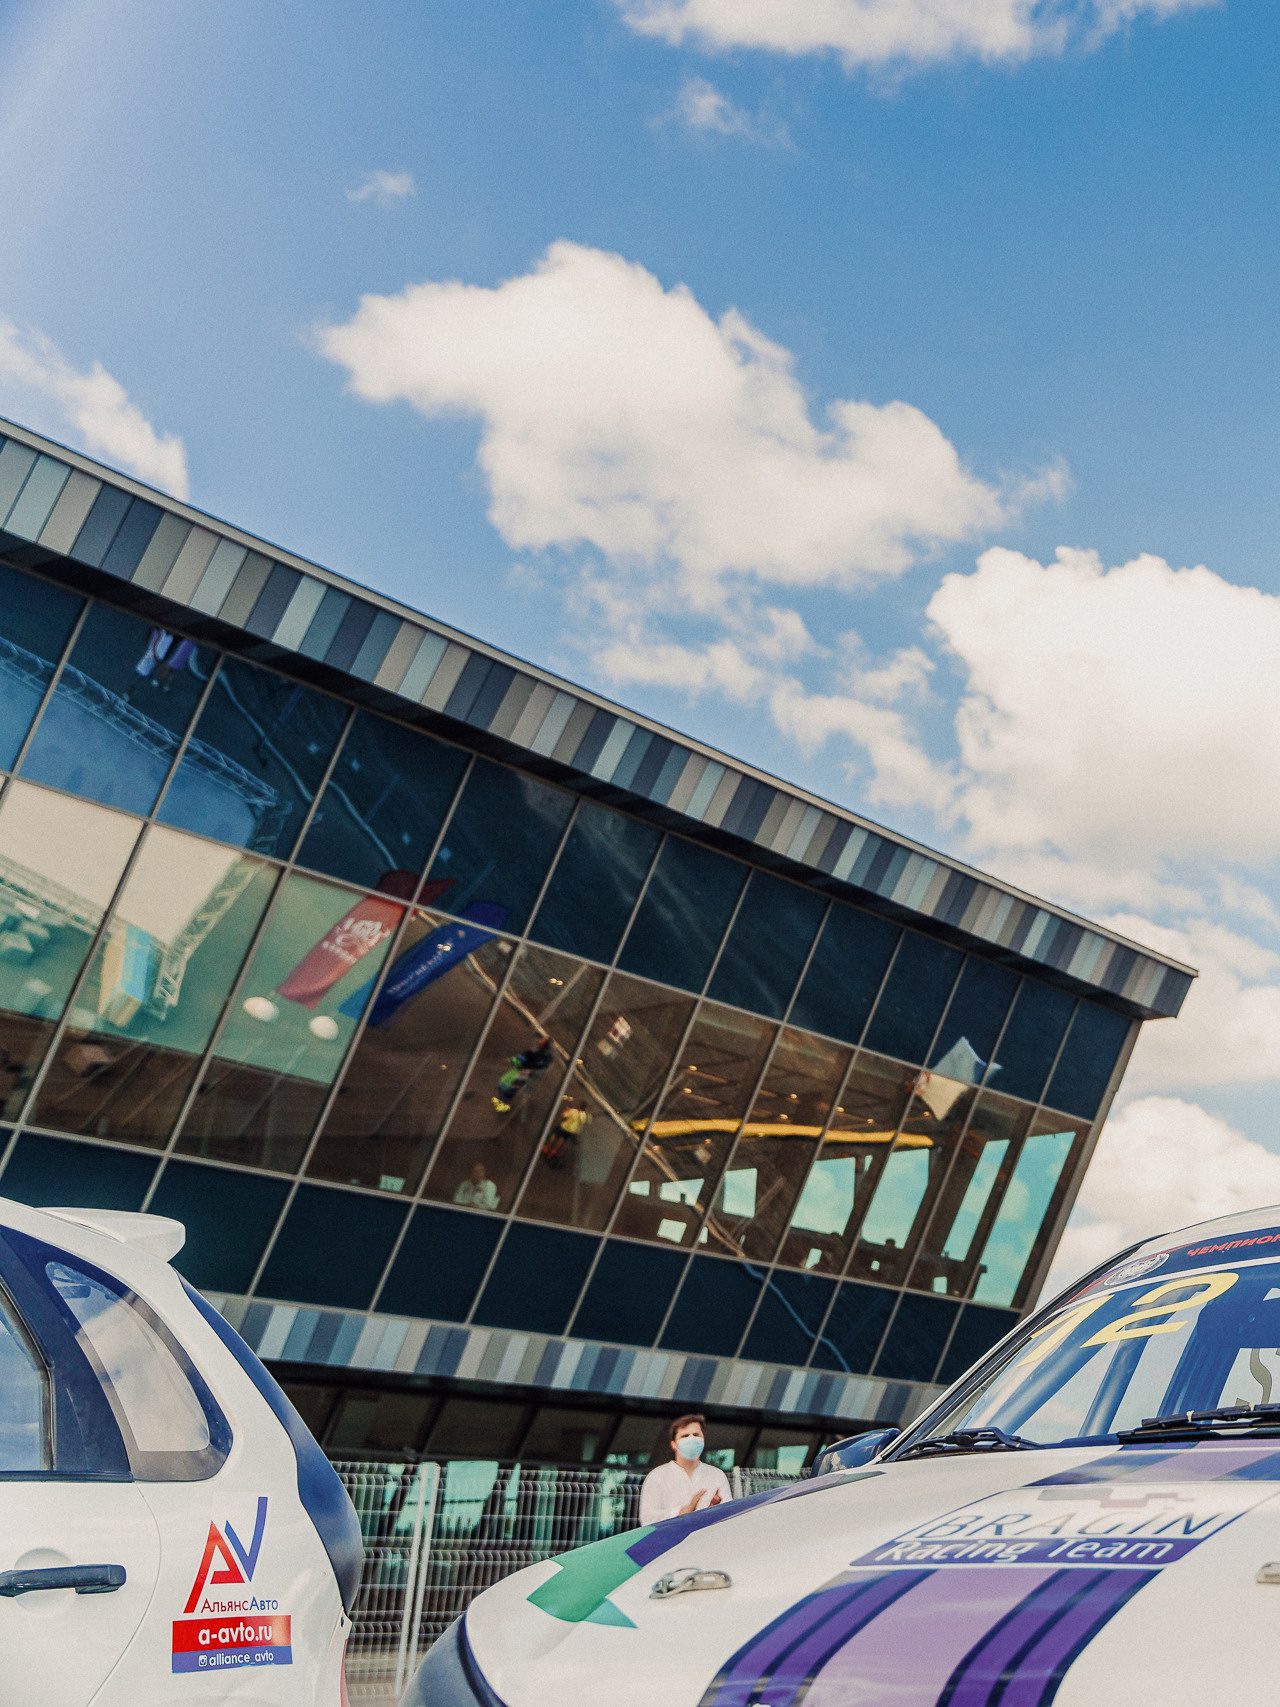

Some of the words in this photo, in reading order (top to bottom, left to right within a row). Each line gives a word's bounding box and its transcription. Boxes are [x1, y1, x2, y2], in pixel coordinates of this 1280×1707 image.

[1017, 1271, 1241, 1369] 12
[875, 1539, 1040, 1564] Racing
[1048, 1538, 1175, 1561] Team
[198, 1621, 273, 1646] a-avto.ru
[208, 1650, 274, 1667] alliance_avto
